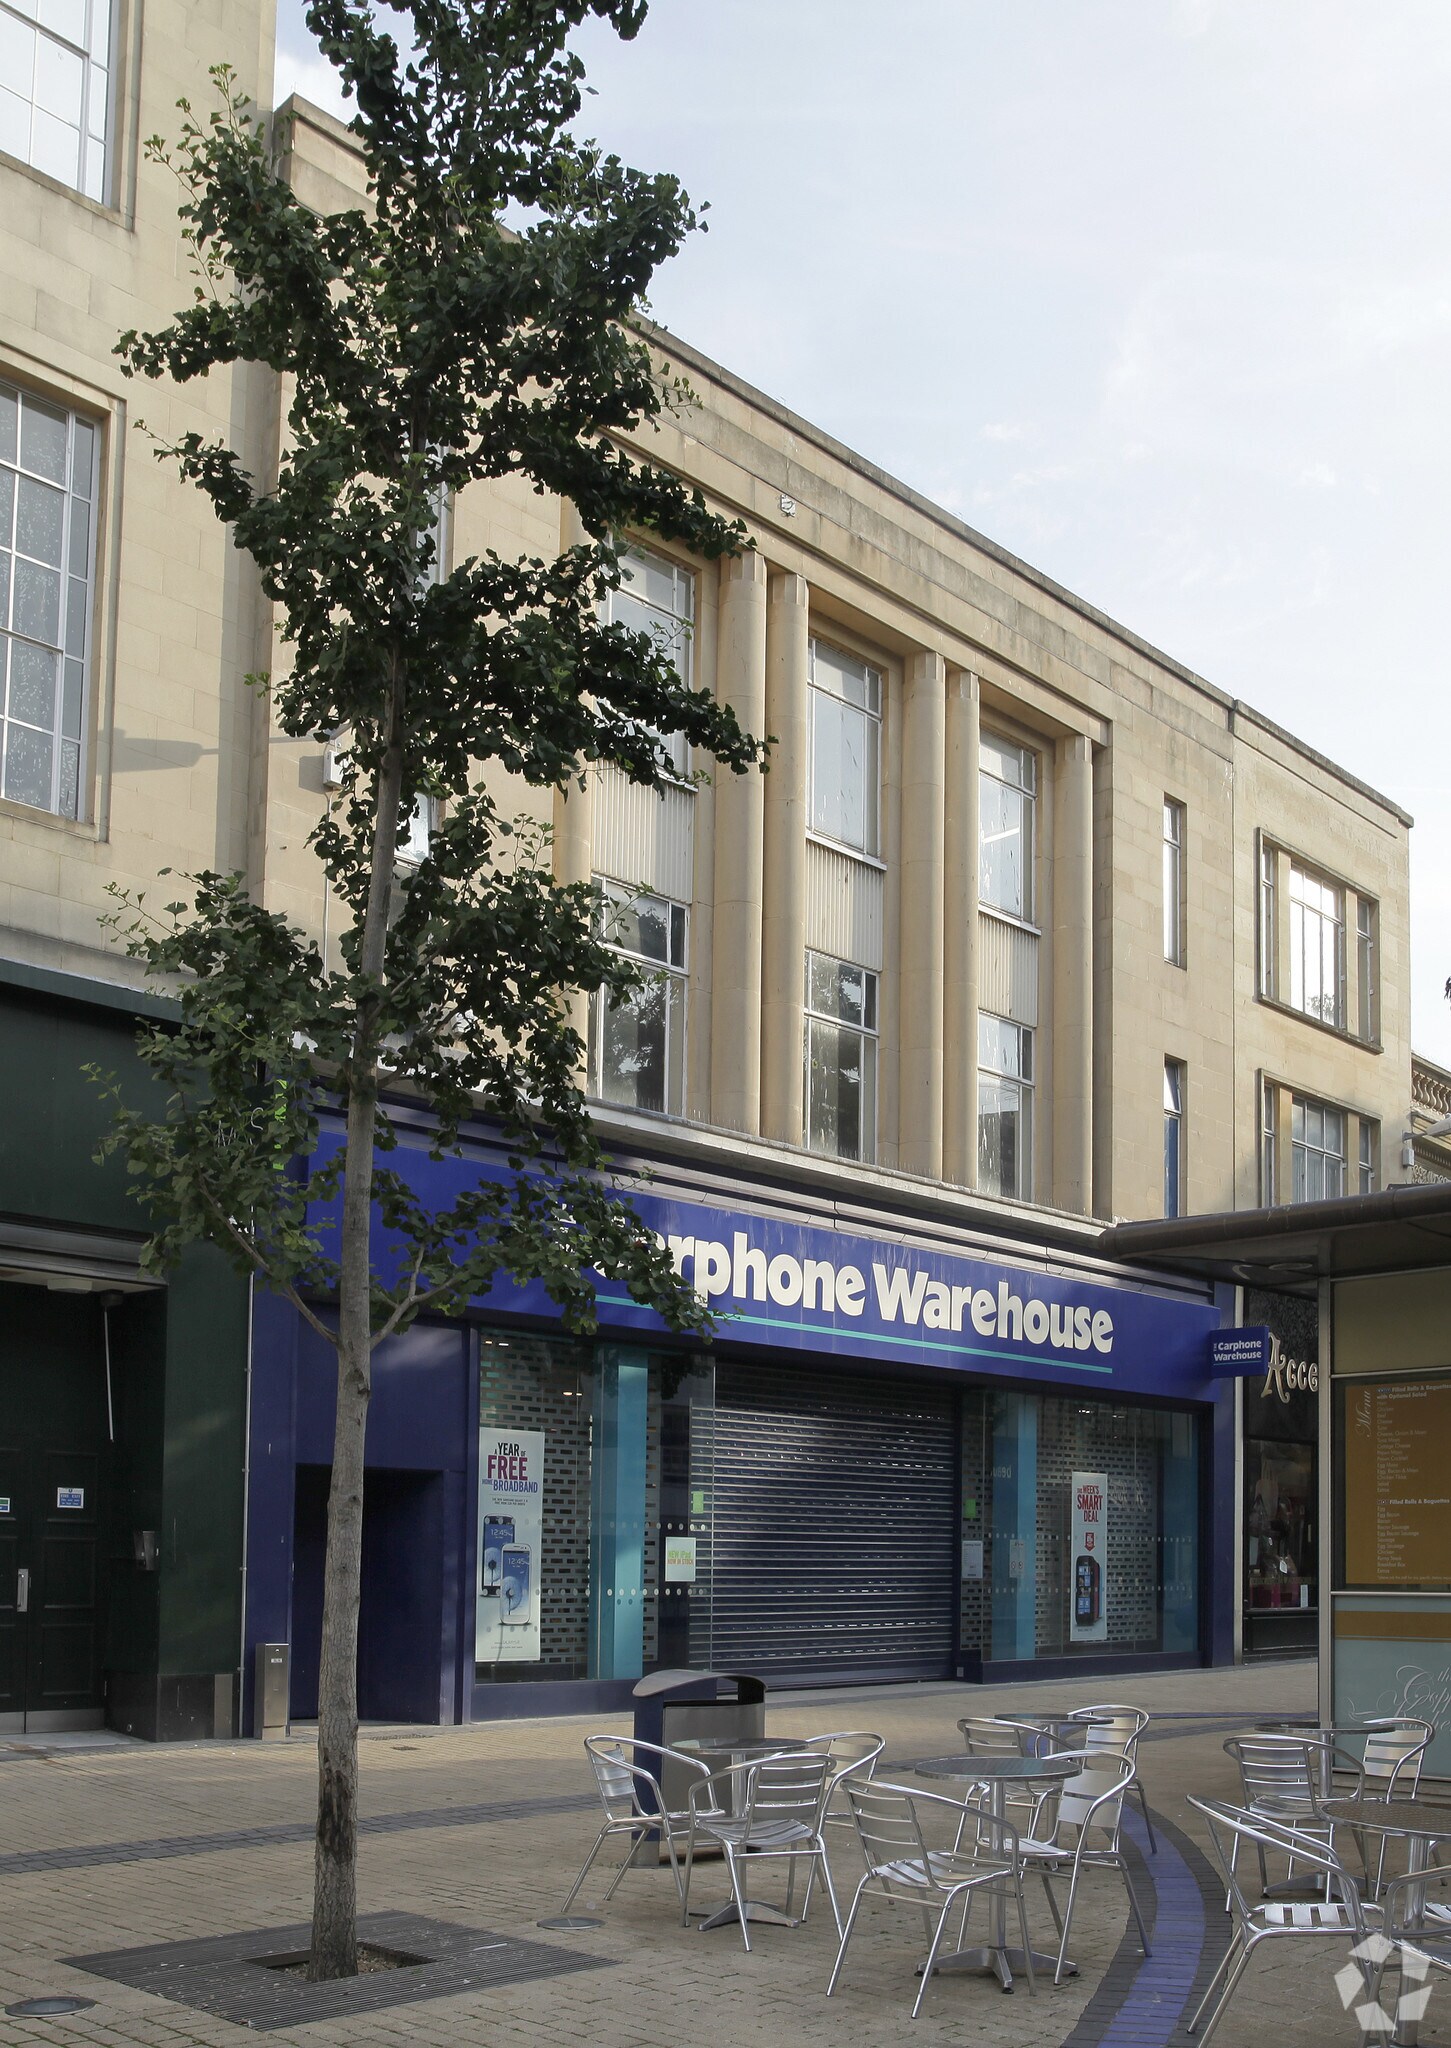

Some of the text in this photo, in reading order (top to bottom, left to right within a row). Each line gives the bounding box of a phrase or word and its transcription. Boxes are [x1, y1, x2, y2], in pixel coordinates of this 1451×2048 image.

[872, 1261, 1114, 1354] Warehouse
[1218, 1340, 1262, 1352] Carphone
[1214, 1351, 1262, 1362] Warehouse
[497, 1442, 520, 1457] YEAR
[487, 1454, 528, 1481] FREE
[493, 1480, 538, 1493] BROADBAND
[1083, 1485, 1099, 1495] WEEK'S
[1077, 1494, 1103, 1511] SMART
[1084, 1510, 1099, 1523] DEAL
